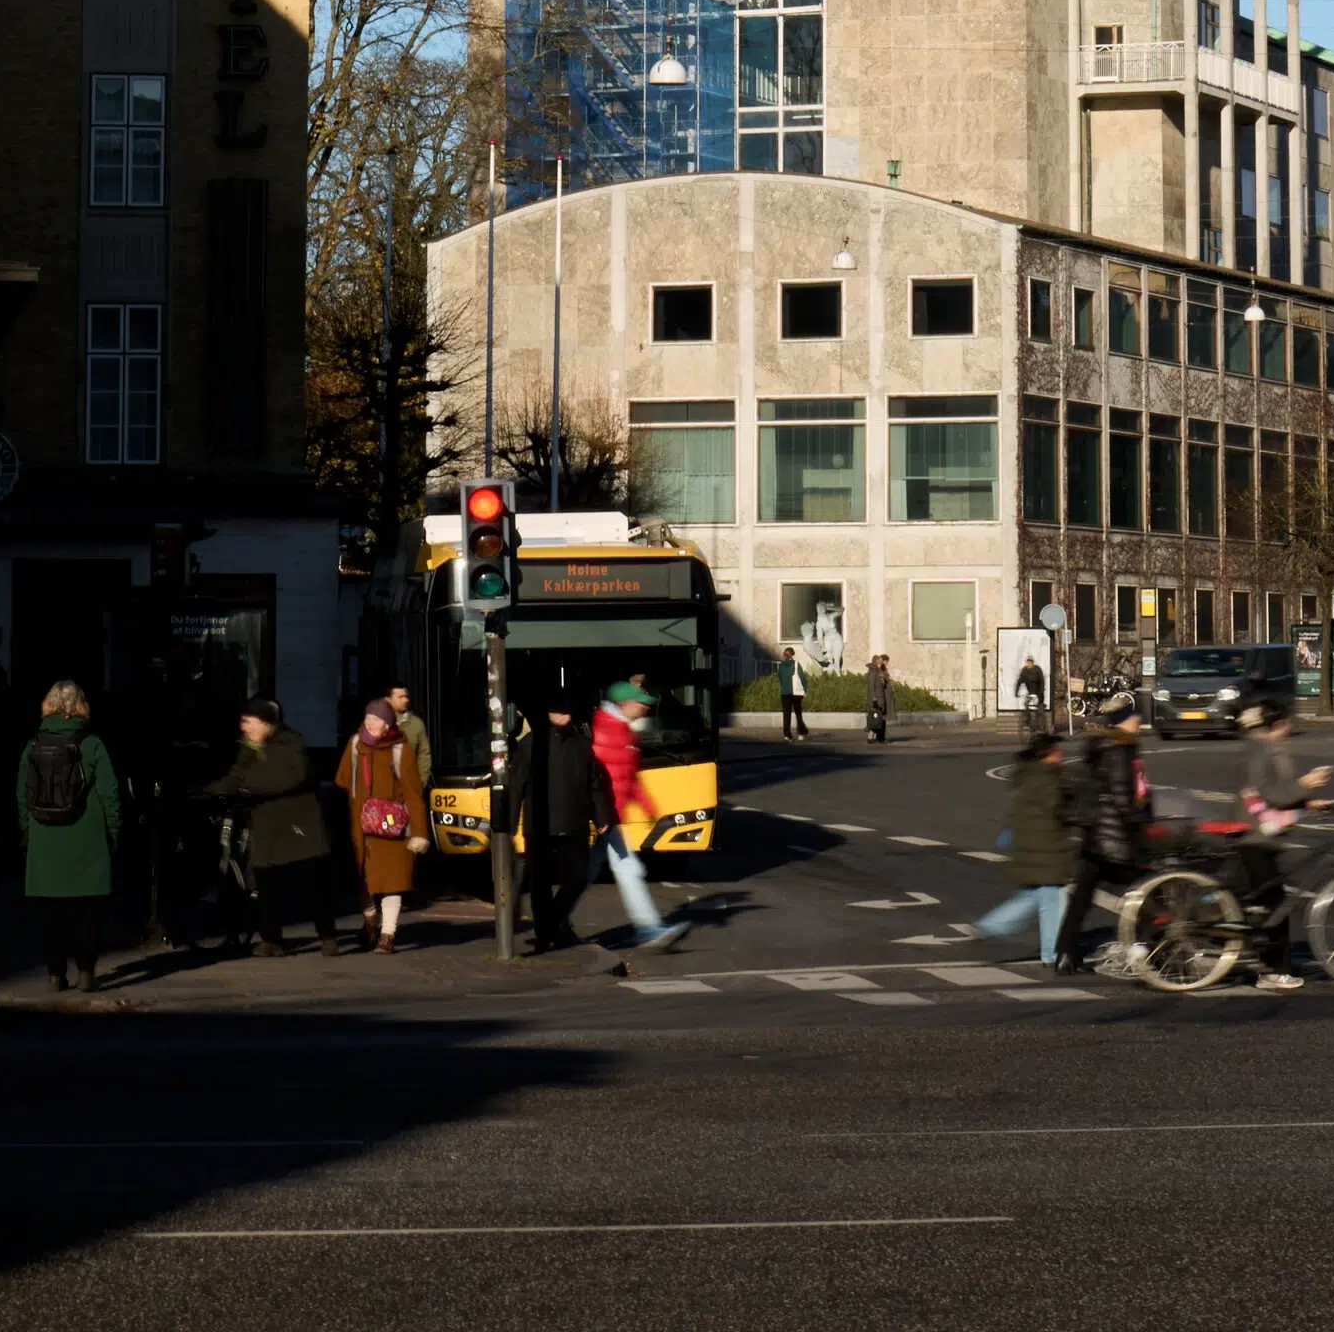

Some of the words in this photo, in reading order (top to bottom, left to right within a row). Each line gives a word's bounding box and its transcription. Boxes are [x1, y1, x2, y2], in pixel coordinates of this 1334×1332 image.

[567, 564, 608, 577] Holme
[543, 579, 640, 597] Kalkærparken
[435, 795, 457, 807] 812
